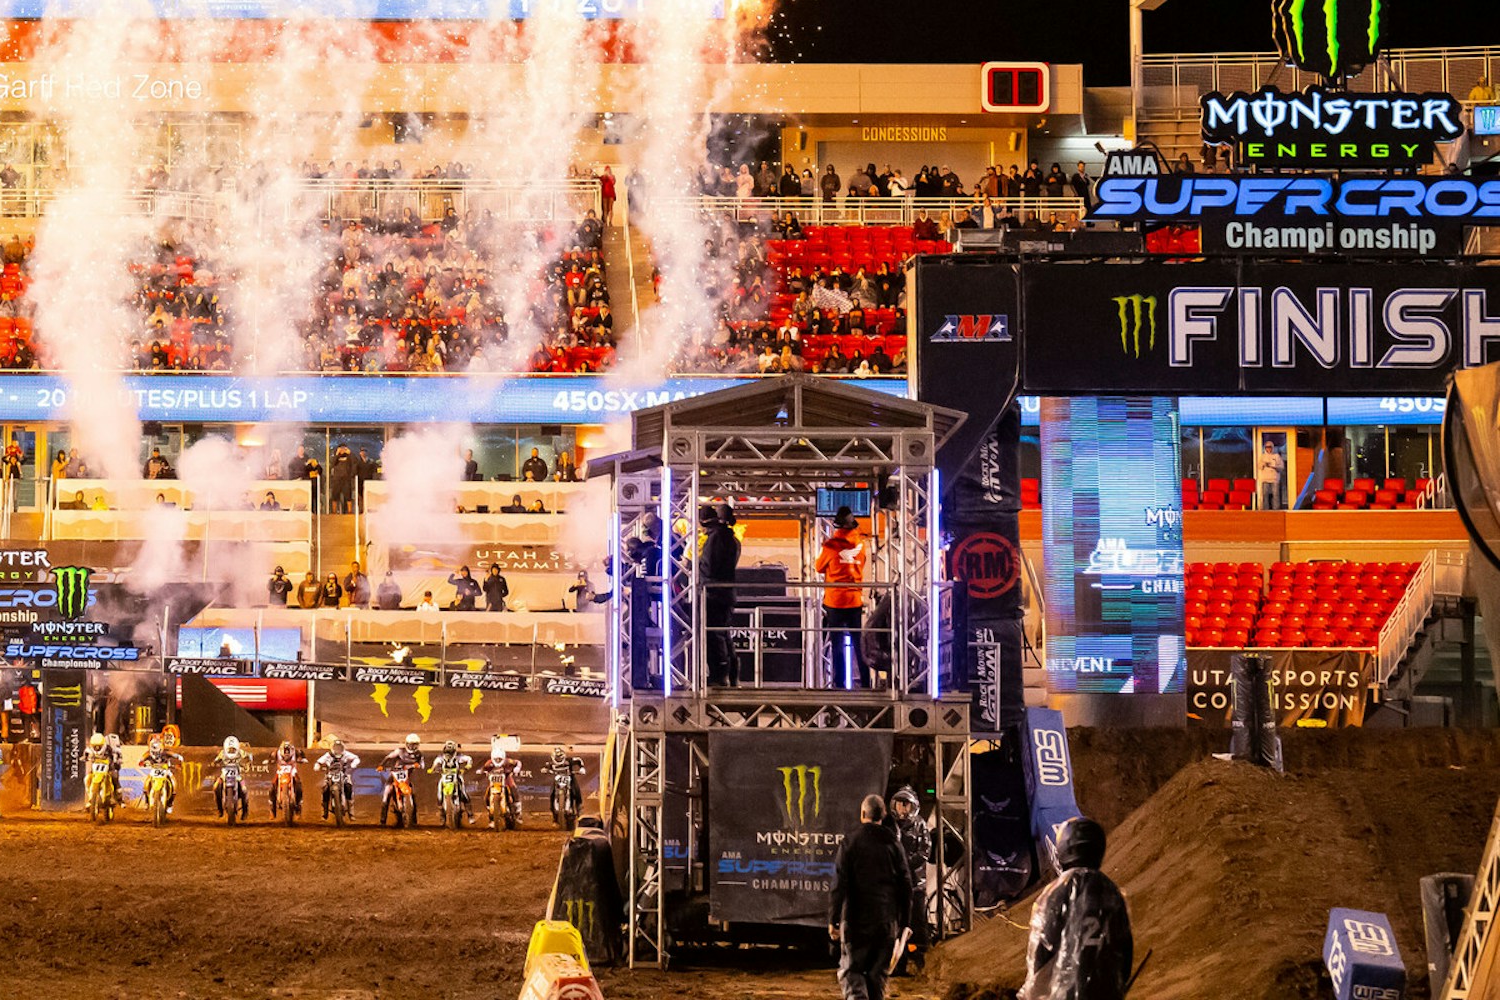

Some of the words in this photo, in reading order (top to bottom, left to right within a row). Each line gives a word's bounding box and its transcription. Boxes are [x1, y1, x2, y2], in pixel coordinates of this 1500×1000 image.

[132, 74, 202, 99] Zone
[1207, 92, 1458, 137] MONSTER
[862, 126, 947, 142] CONCESSIONS
[1248, 143, 1420, 158] ENERGY
[1108, 156, 1159, 175] AMA
[930, 313, 1012, 342] AMA
[36, 388, 66, 407] 20
[264, 390, 308, 409] LAP
[552, 390, 637, 411] 450SX
[476, 550, 537, 561] UTAH
[32, 621, 104, 635] MONSTER
[5, 645, 139, 659] SUPERCROSS
[41, 658, 101, 670] Championship
[1193, 670, 1236, 686] UTA
[1271, 670, 1360, 688] SPORTS
[1193, 691, 1354, 711] COISSION
[1033, 728, 1070, 786] WPS
[721, 851, 742, 860] AMA
